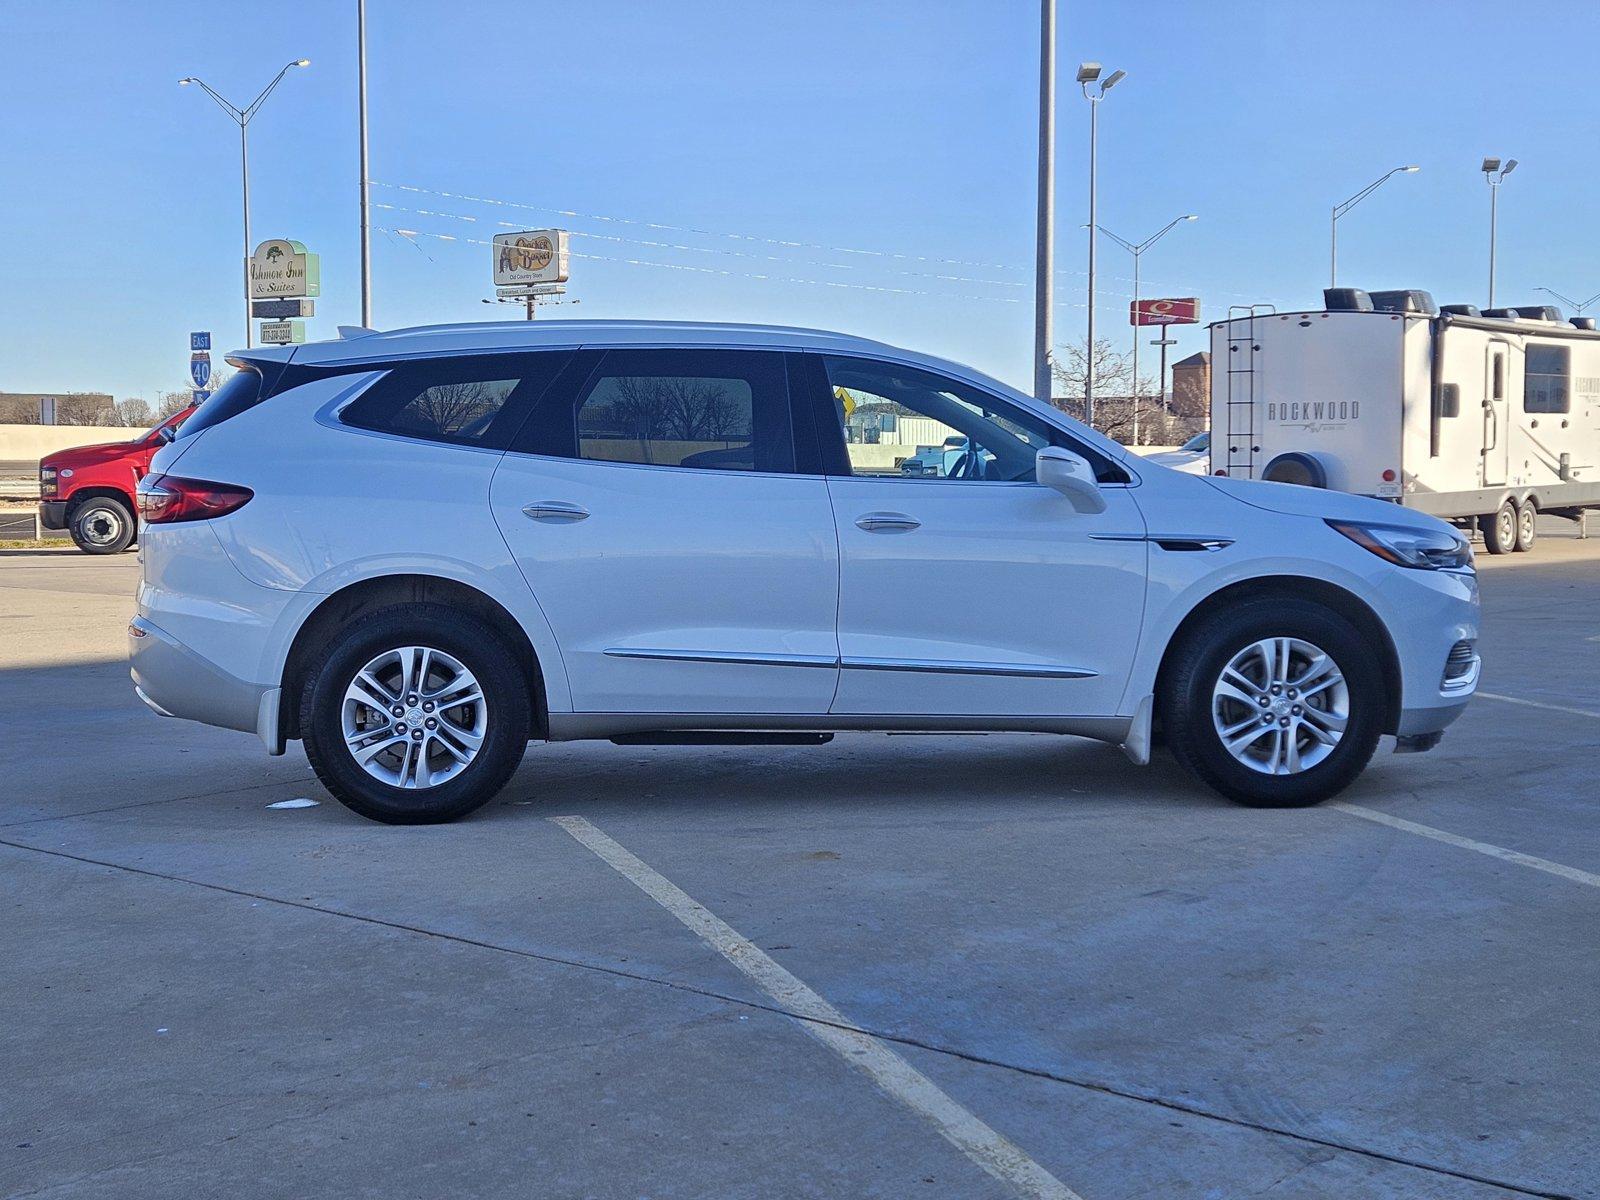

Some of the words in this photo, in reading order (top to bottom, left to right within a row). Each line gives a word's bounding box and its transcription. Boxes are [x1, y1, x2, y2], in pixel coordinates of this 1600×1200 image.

[285, 261, 303, 278] Inn
[255, 283, 264, 293] &
[266, 281, 296, 292] Suites
[192, 336, 209, 348] EAST
[193, 363, 209, 382] 40
[1268, 400, 1360, 420] ROCKWOOD
